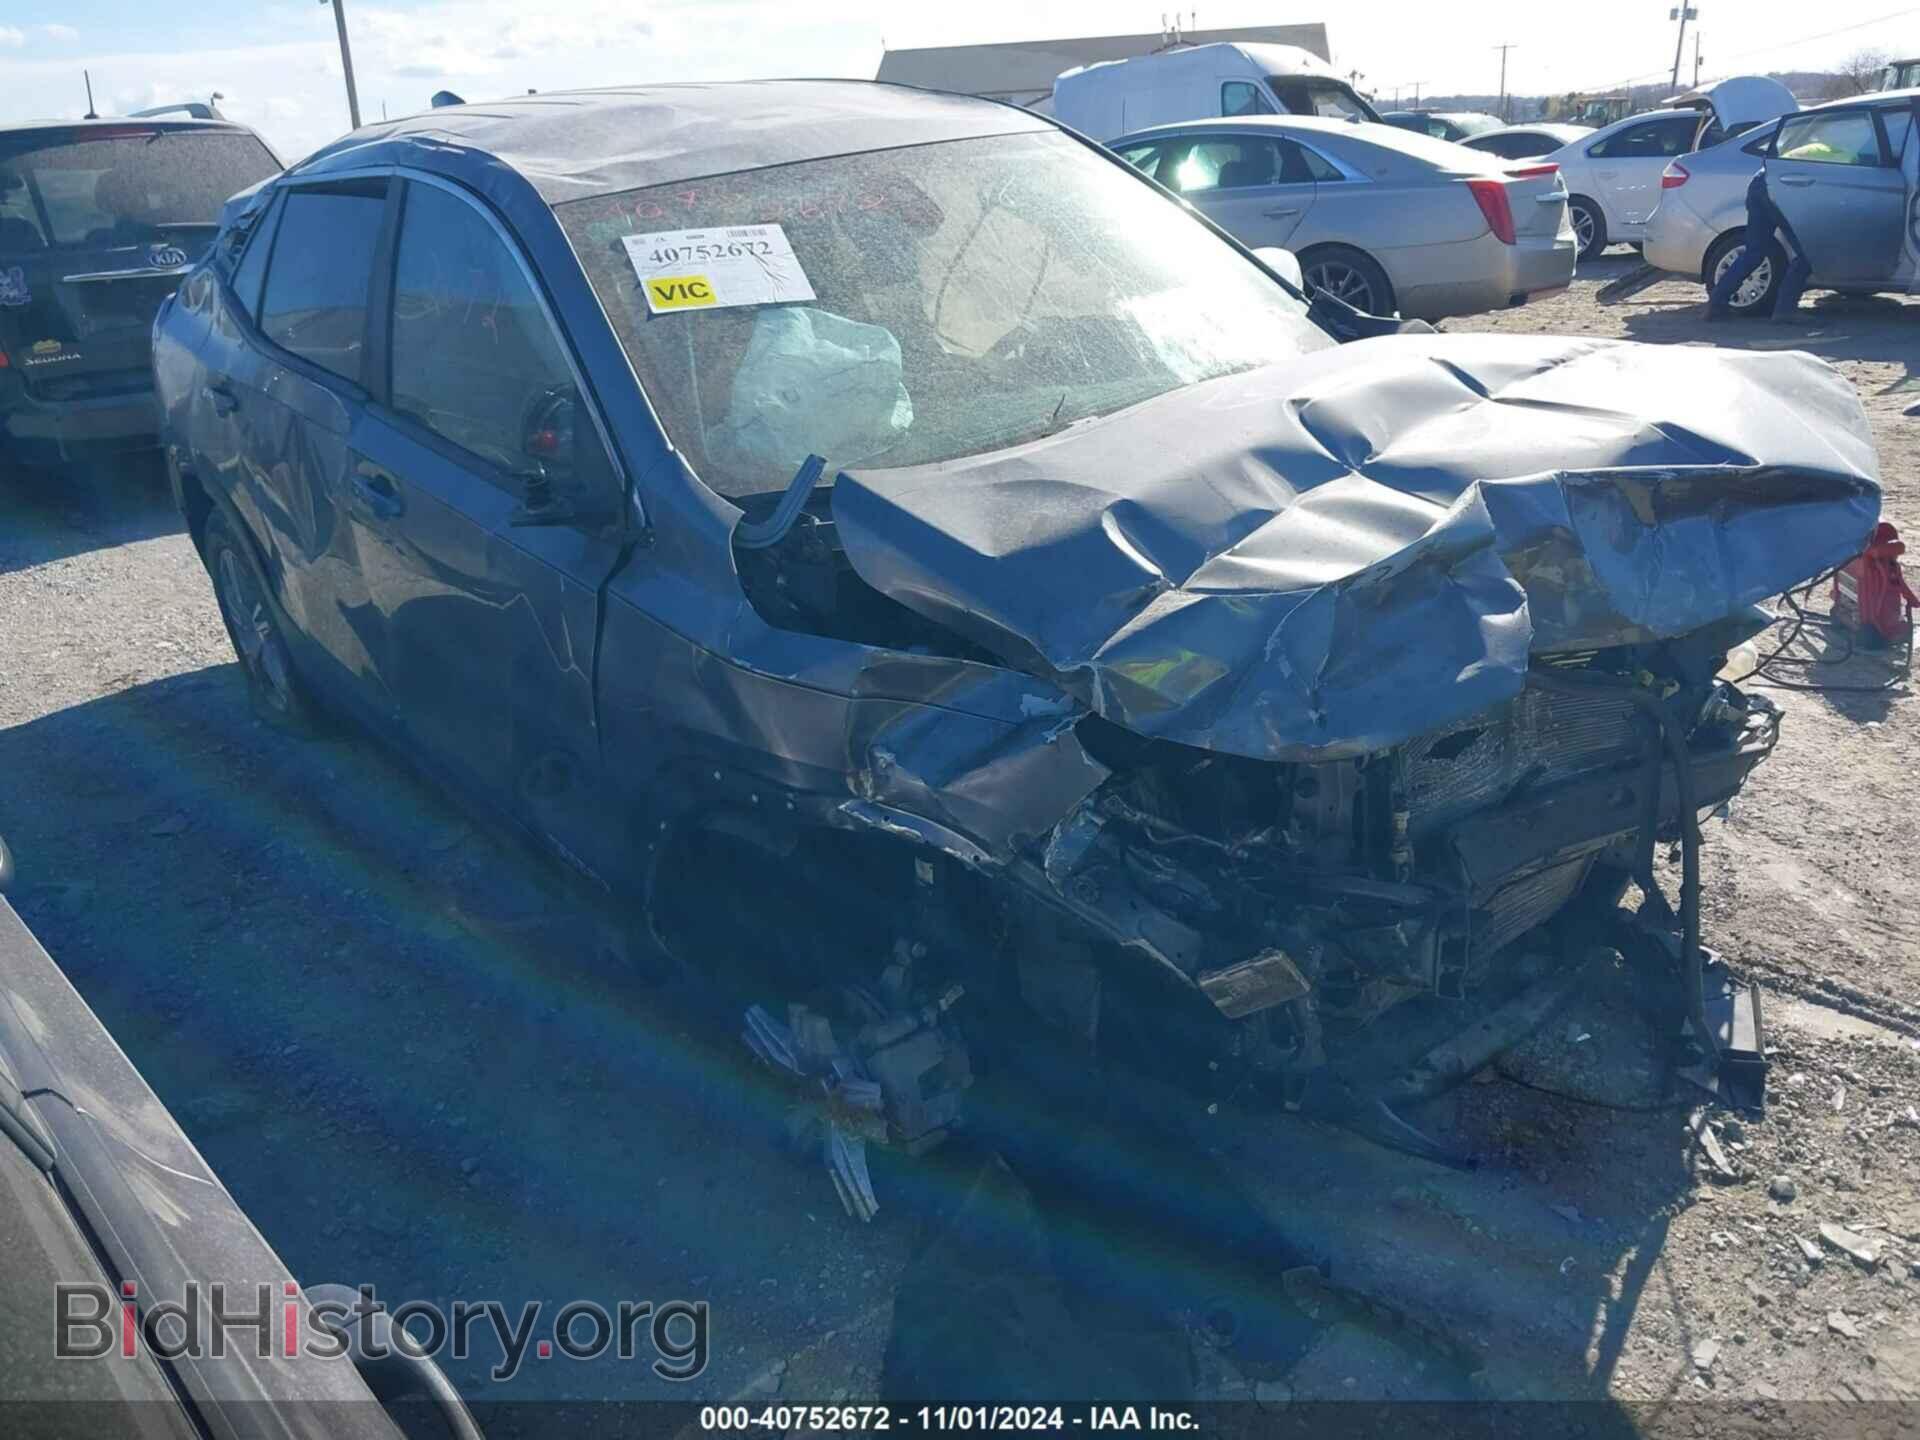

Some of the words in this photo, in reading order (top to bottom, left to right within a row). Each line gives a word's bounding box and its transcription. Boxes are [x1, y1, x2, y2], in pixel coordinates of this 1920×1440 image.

[154, 251, 183, 265] KIA
[649, 241, 773, 263] 40752672
[654, 282, 710, 301] VIC
